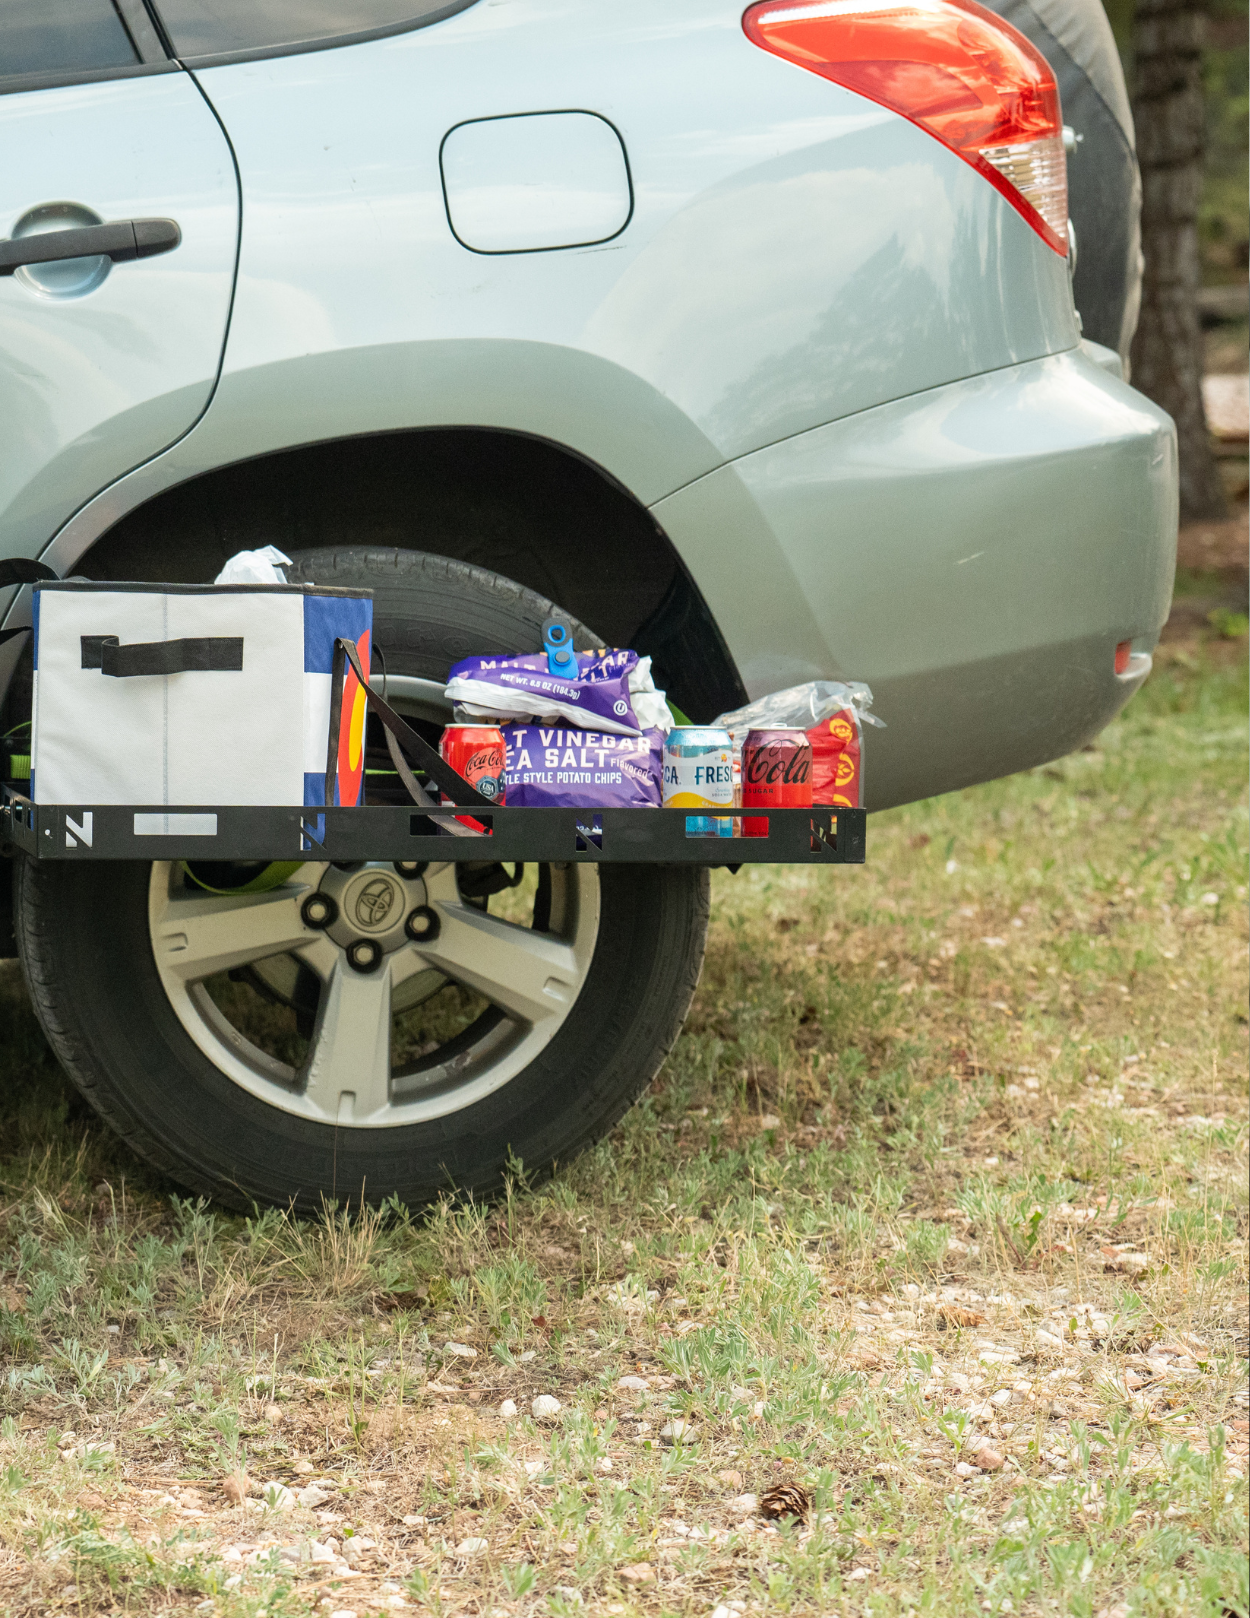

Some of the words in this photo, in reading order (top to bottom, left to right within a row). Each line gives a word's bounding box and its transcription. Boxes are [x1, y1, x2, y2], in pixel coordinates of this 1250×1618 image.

[500, 673, 514, 682] NET
[515, 677, 528, 686] WT.
[529, 679, 540, 688] 8.5
[541, 683, 552, 691] OZ
[552, 685, 580, 700] (184.3g)
[539, 729, 651, 754] VINEGAR
[545, 748, 610, 768] SALT
[610, 758, 648, 779] Flavored
[523, 772, 553, 784] STYLE
[557, 771, 592, 784] POTATO
[595, 772, 622, 784] CHIPS
